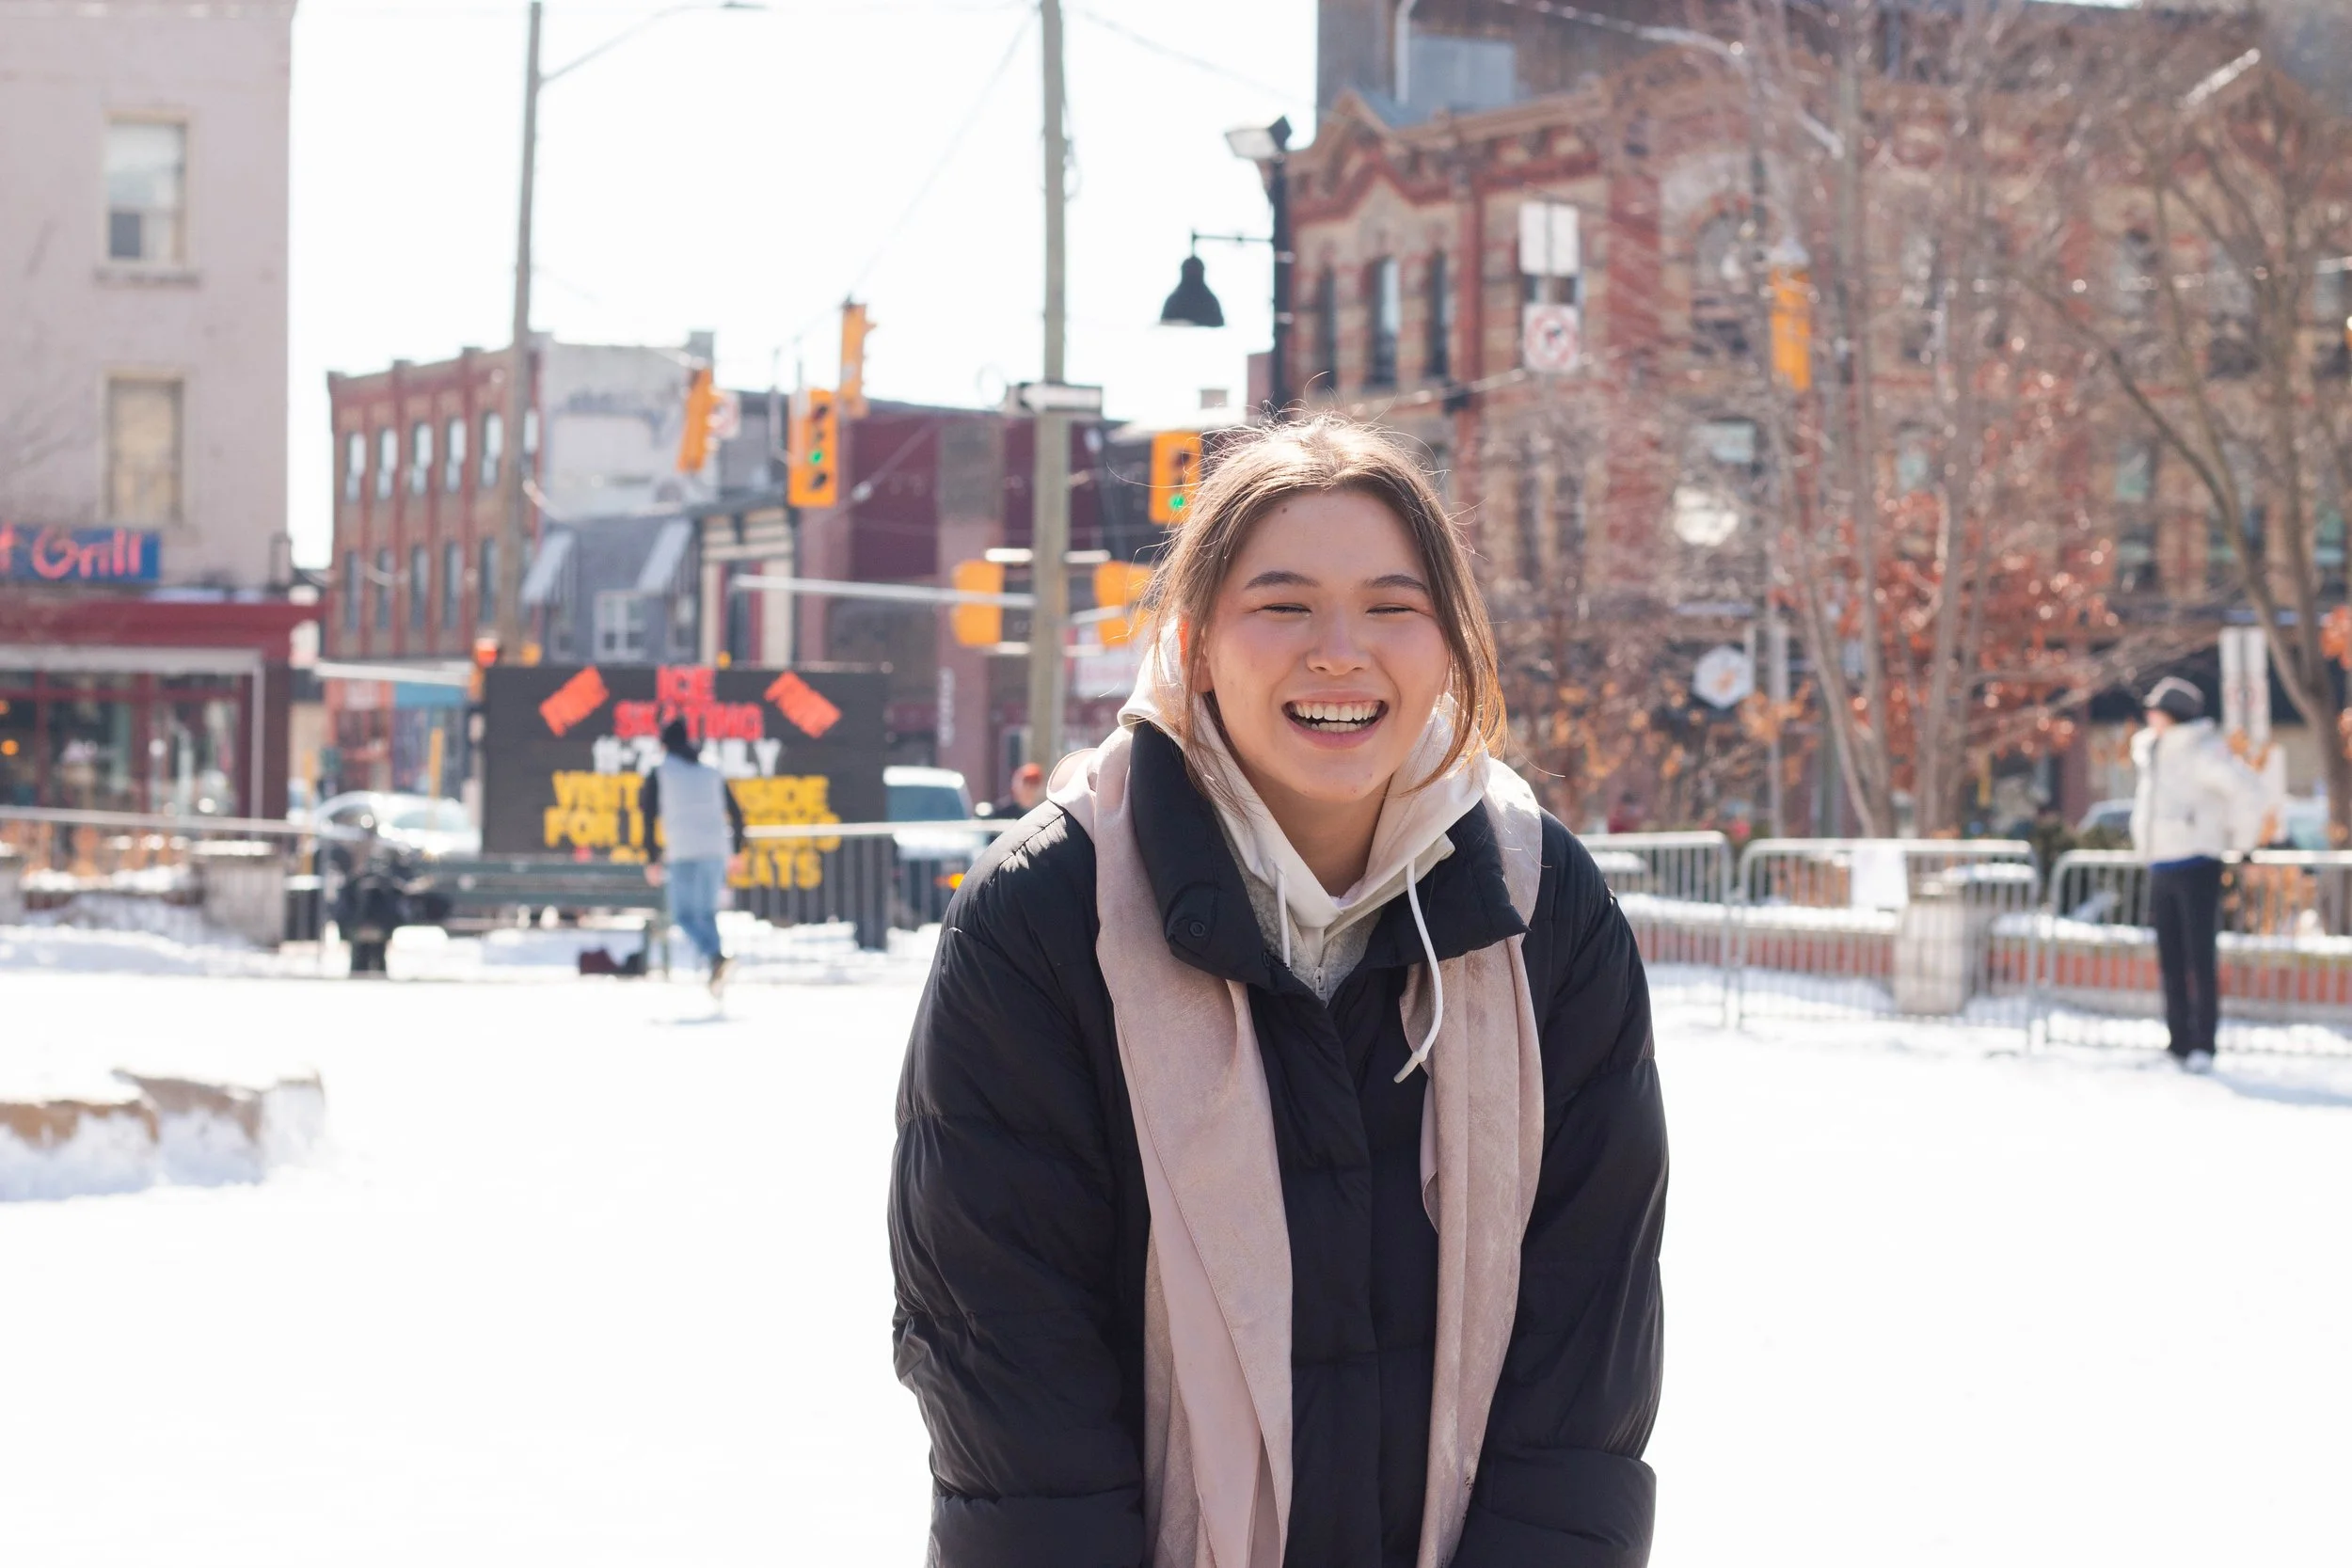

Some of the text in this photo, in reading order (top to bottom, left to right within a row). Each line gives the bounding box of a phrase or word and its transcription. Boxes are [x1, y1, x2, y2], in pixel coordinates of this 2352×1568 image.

[31, 524, 141, 579] Grill
[656, 665, 716, 703] ICE
[697, 737, 783, 778] AILY
[544, 806, 619, 847] FOR
